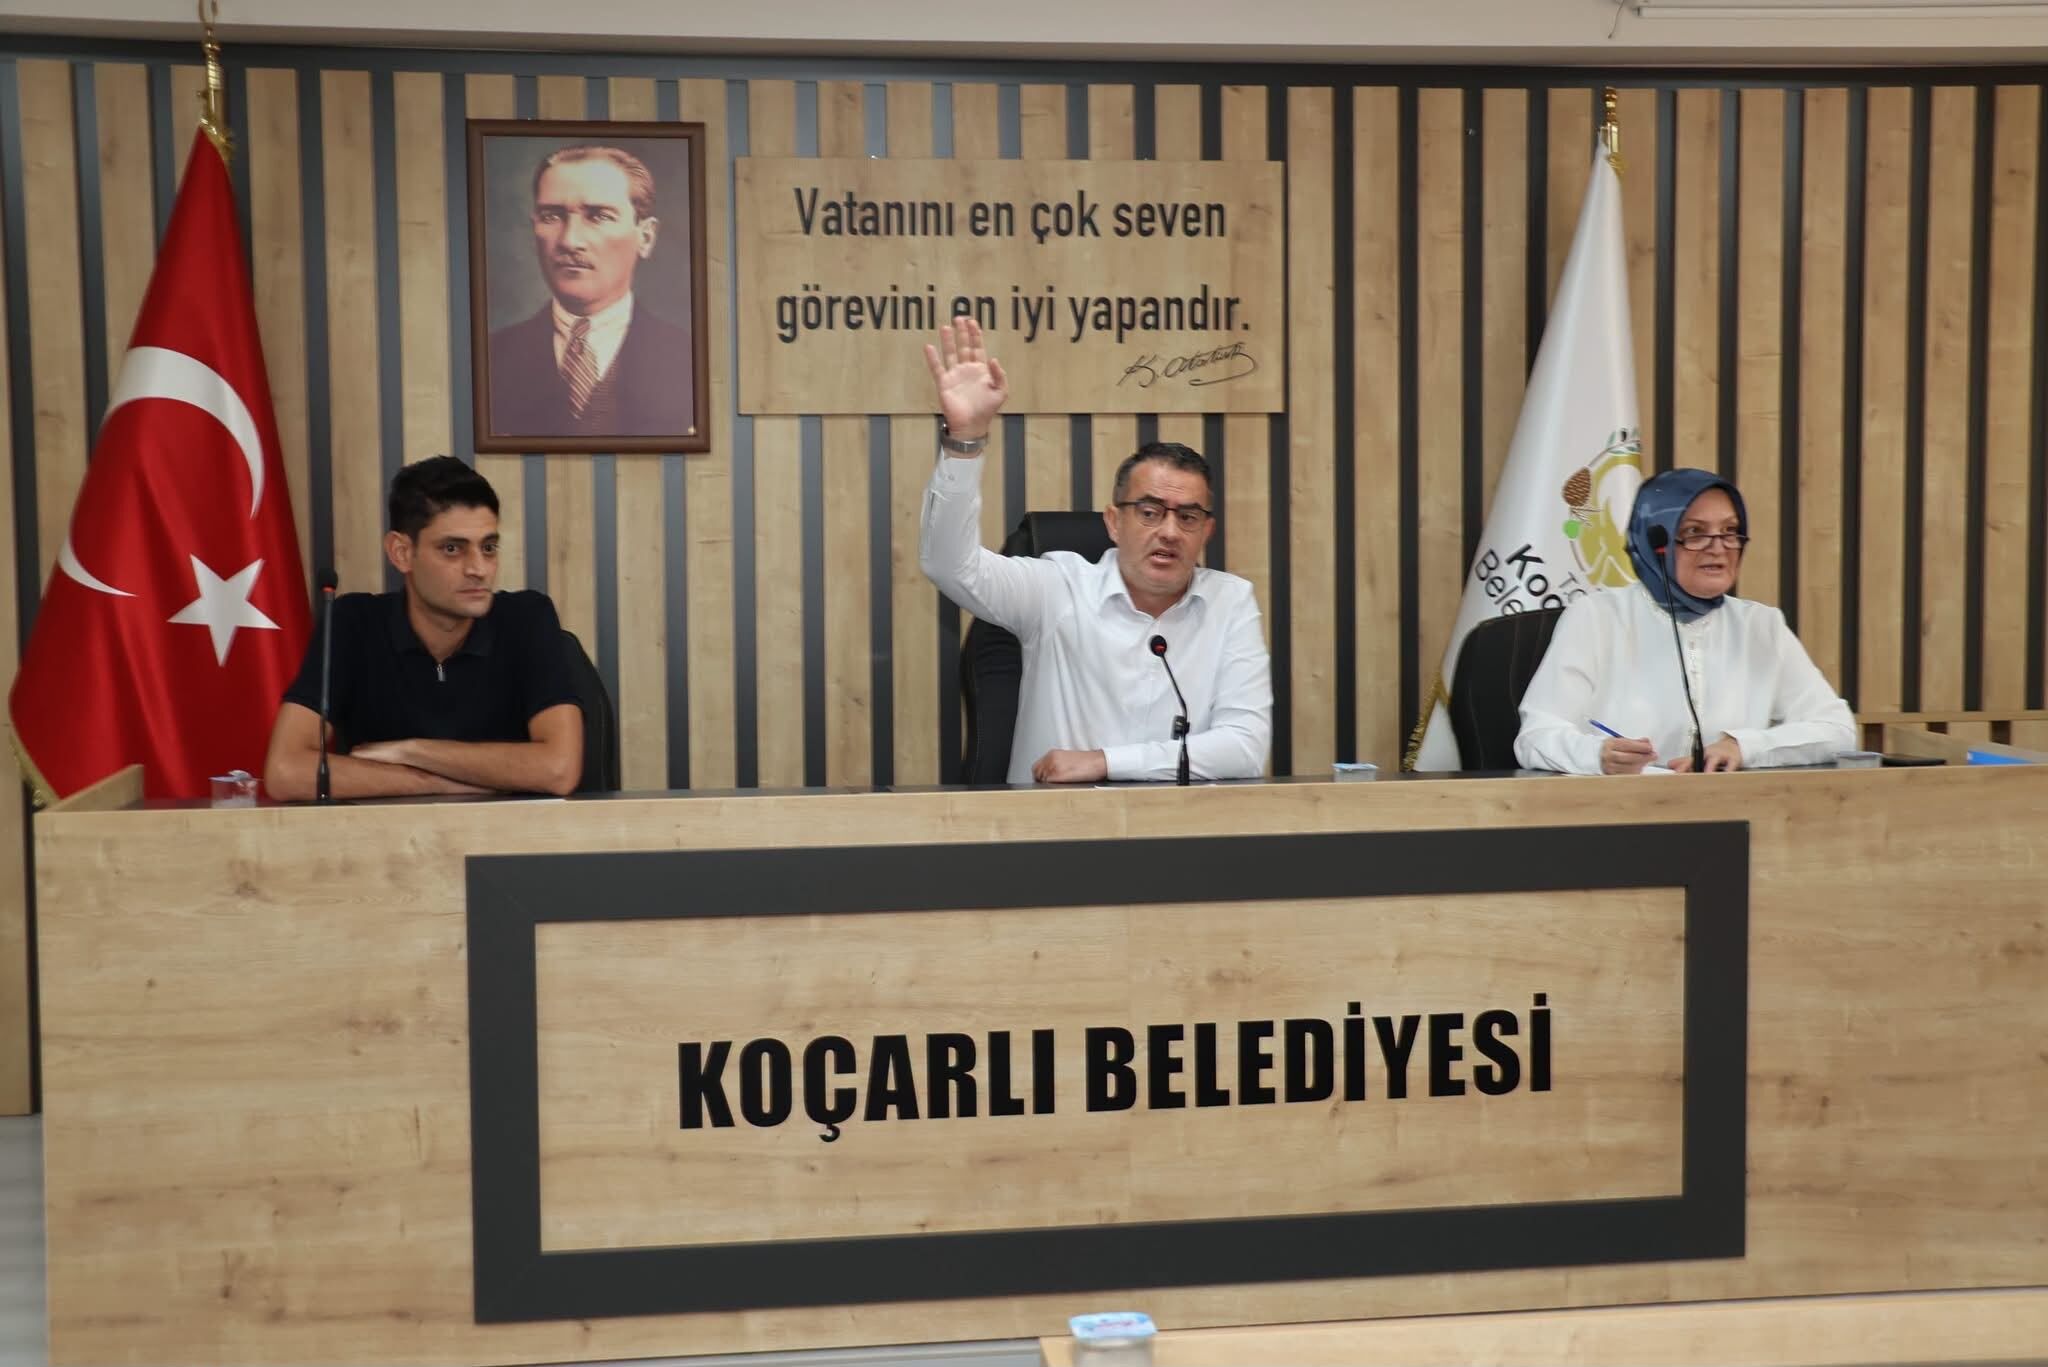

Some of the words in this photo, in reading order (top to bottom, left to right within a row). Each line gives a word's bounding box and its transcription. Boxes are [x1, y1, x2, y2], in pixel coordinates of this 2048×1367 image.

[794, 187, 954, 237] Vatanını
[969, 202, 1014, 237] en
[1030, 189, 1101, 245] çok
[1113, 202, 1226, 238] seven
[776, 284, 936, 344] görevini
[952, 296, 996, 331] en
[1012, 285, 1055, 344] iyi
[1068, 284, 1250, 344] yapandır.
[678, 1028, 1055, 1143] KOÇARLI
[1085, 992, 1552, 1113] BELEDİYESİ
